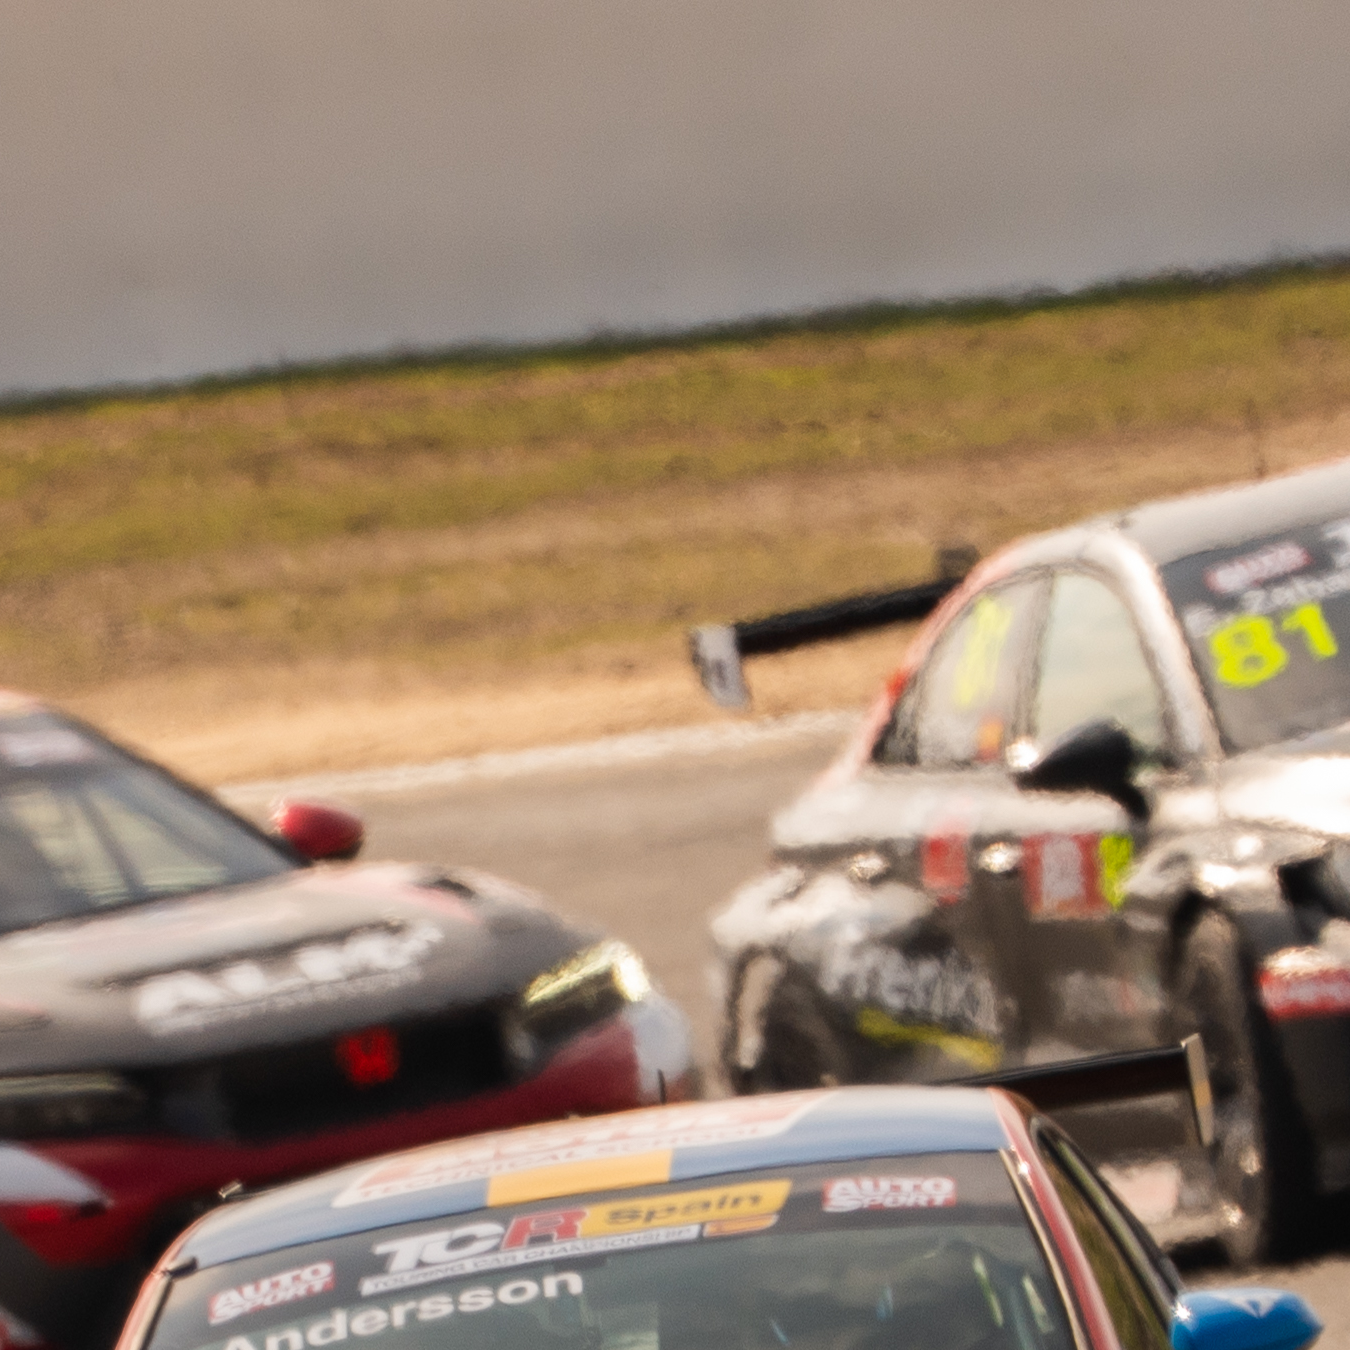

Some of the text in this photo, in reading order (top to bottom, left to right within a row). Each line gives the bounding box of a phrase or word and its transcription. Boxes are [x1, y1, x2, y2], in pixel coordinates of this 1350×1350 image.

[1209, 602, 1339, 690] 81
[829, 1176, 955, 1197] AUTO
[371, 1226, 694, 1290] TOURING CAR CHAMPIONSHIP
[373, 1188, 763, 1276] TCR Spain
[213, 1262, 332, 1310] AUTO
